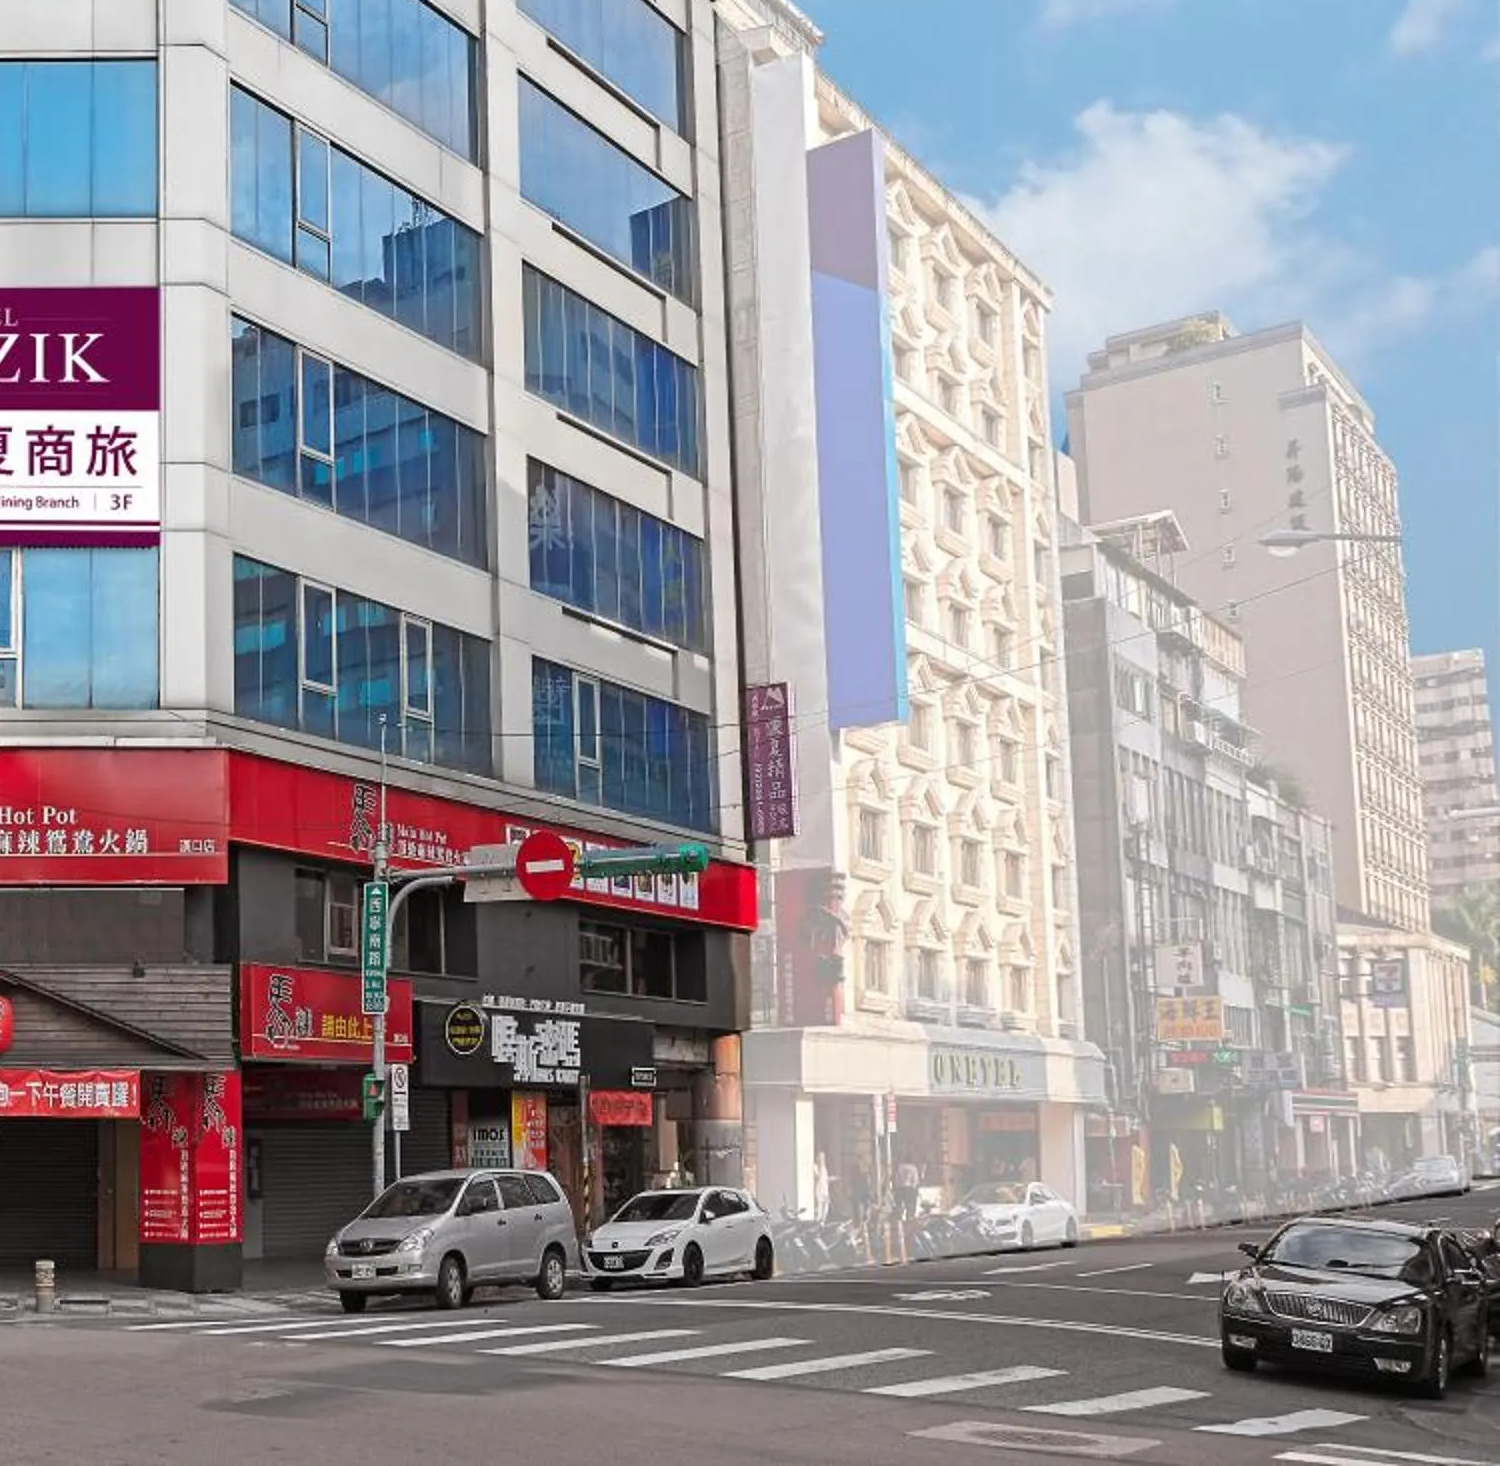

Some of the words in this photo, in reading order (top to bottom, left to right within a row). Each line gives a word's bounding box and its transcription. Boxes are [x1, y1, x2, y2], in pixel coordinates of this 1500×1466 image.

[35, 495, 80, 509] Branch
[109, 494, 133, 511] 3F
[42, 807, 77, 825] Pot
